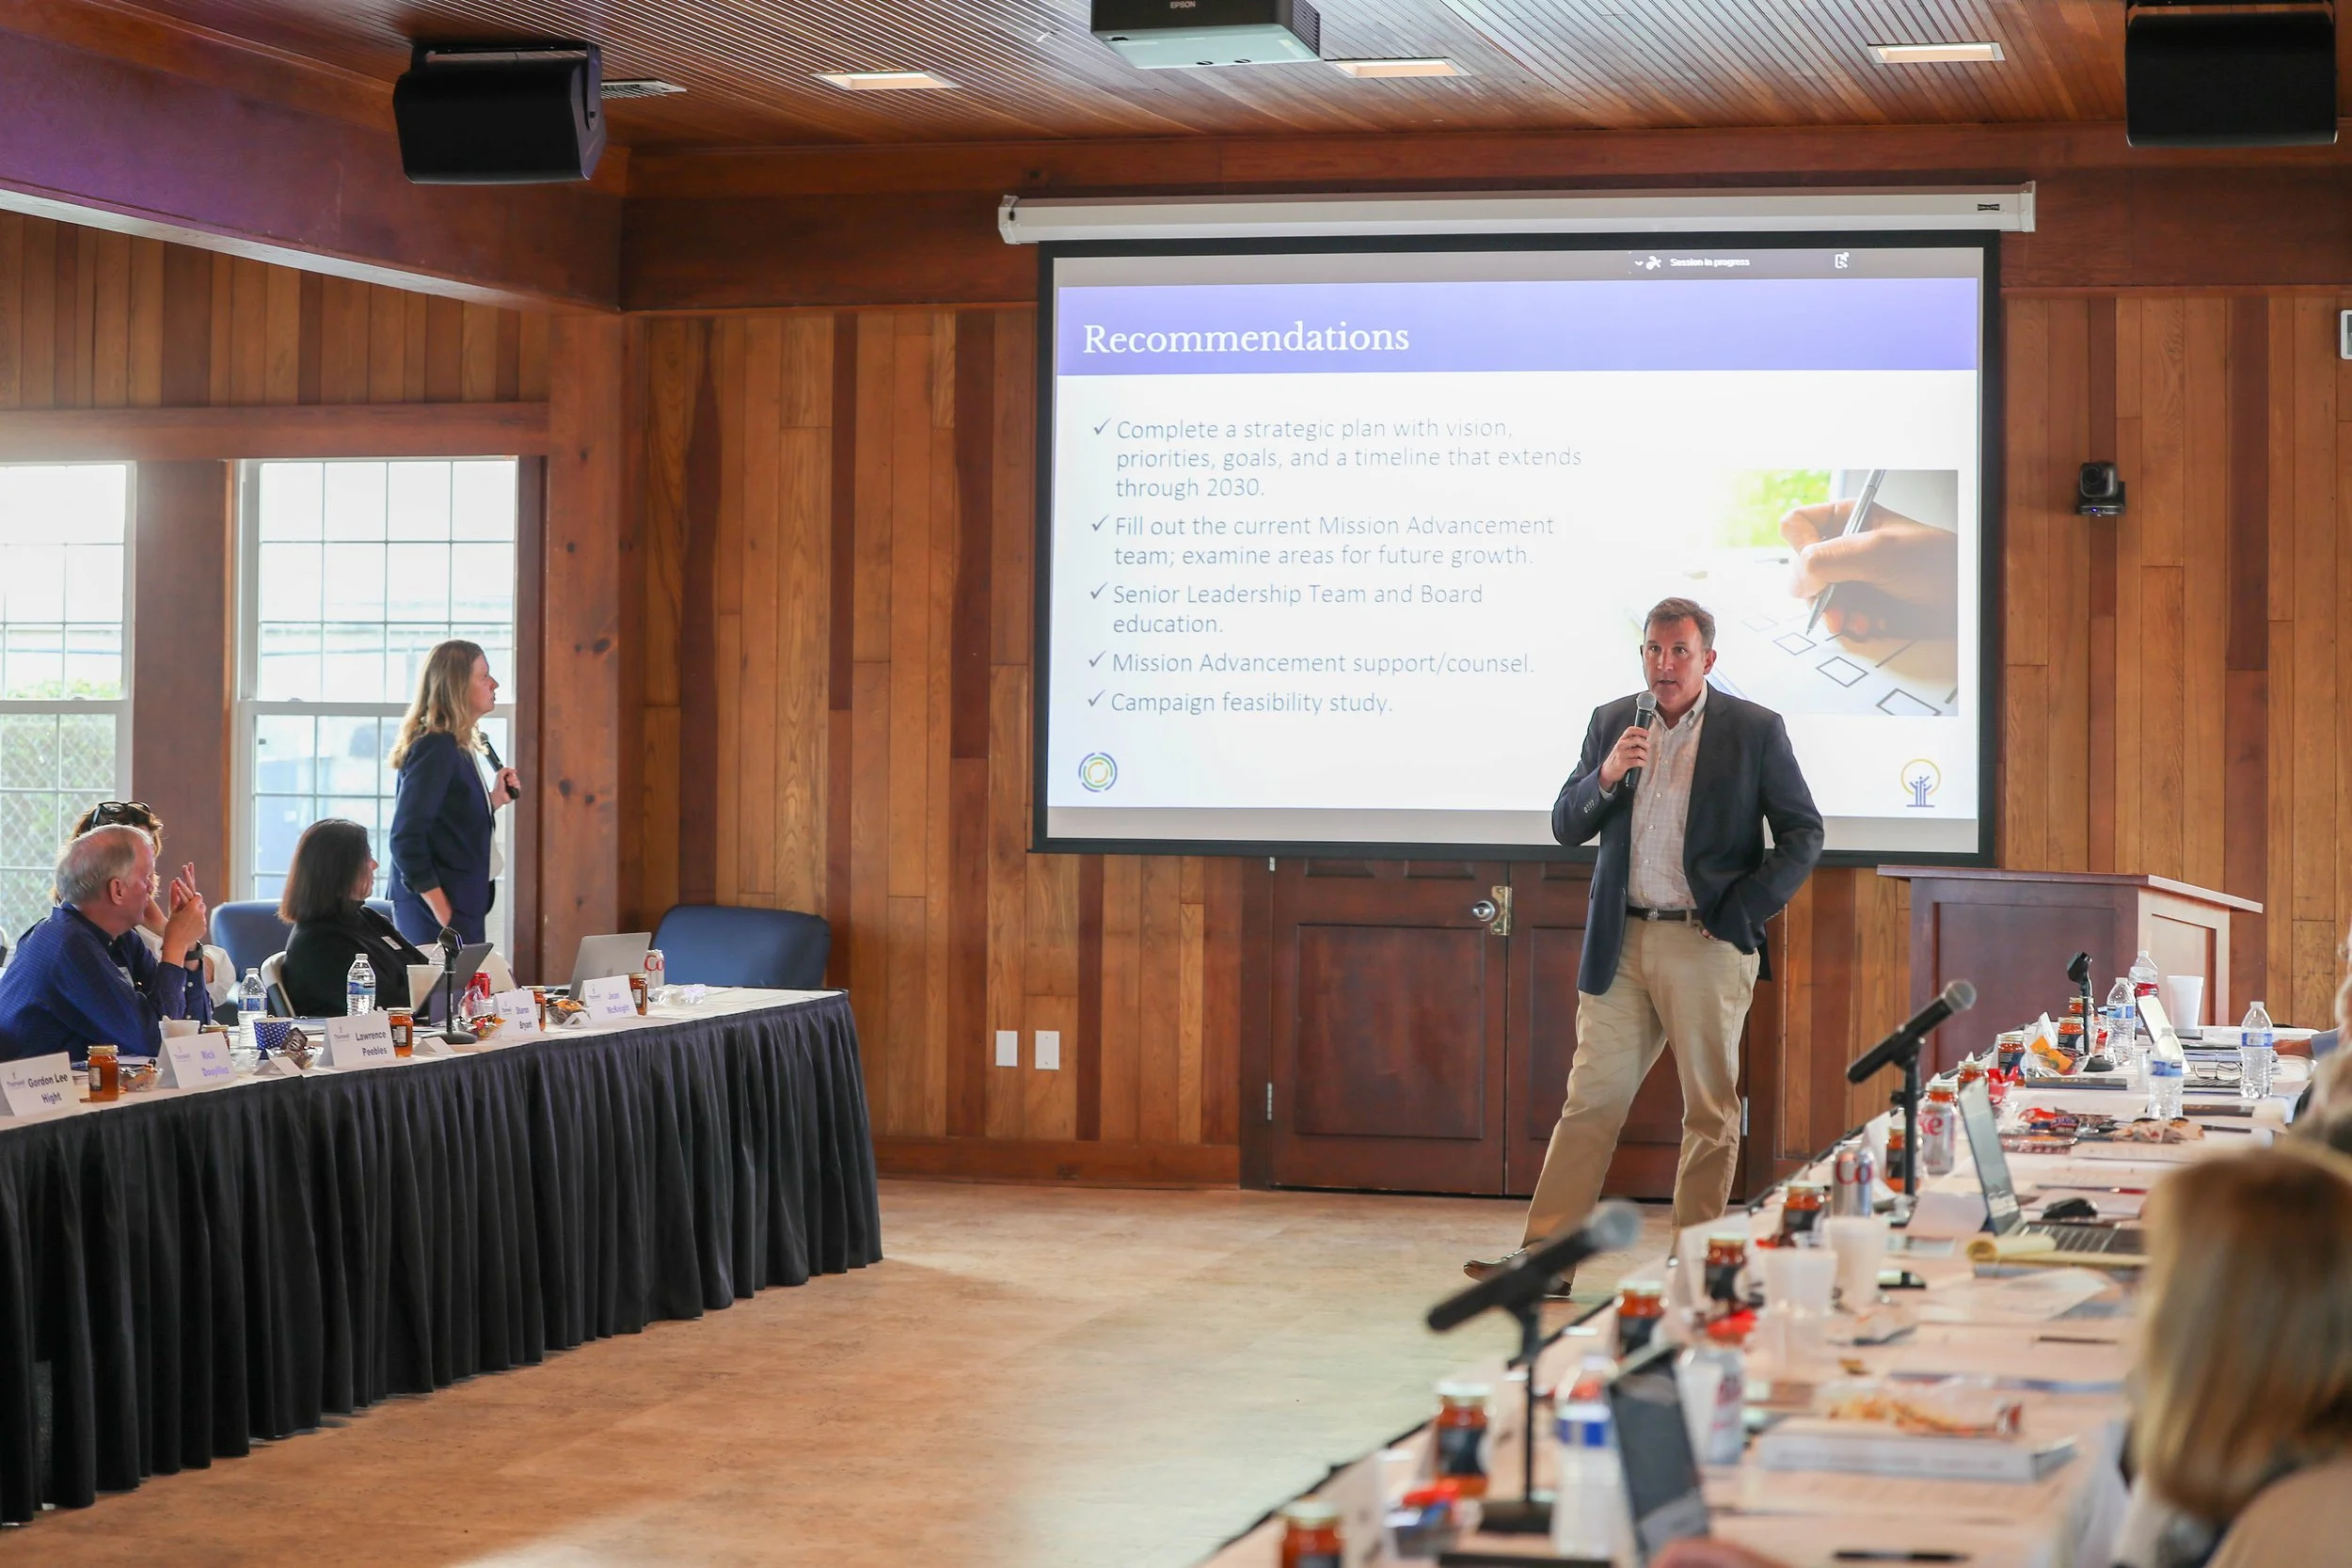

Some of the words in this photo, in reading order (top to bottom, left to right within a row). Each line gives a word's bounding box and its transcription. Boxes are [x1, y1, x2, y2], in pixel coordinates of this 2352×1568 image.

[1169, 1, 1197, 9] EPSON
[1670, 258, 1704, 267] Session
[1713, 259, 1751, 267] progress
[1082, 320, 1409, 354] Recommendations
[1117, 419, 1218, 443] Complete
[1225, 424, 1236, 438] a
[1244, 420, 1335, 442] strategic
[1342, 419, 1386, 441] plan
[1392, 418, 1438, 437] with
[1446, 422, 1513, 440] vision,
[1117, 449, 1216, 472] priorities,
[1222, 447, 1282, 471] goals,
[1290, 447, 1328, 467] and
[1336, 451, 1347, 467] a
[1354, 447, 1441, 467] timeline
[1447, 447, 1491, 467] that
[1498, 446, 1581, 466] extends
[1115, 477, 1199, 501] through
[1206, 478, 1264, 498] 2030.
[1116, 515, 1143, 535] Fill
[1150, 518, 1186, 535] out
[1192, 515, 1227, 535] the
[1233, 516, 1311, 535] current
[1319, 515, 1399, 535] Mission
[1406, 515, 1555, 534] Advancement
[1114, 547, 1174, 568] team;
[1182, 549, 1271, 565] examine
[1278, 549, 1334, 564] areas
[1341, 544, 1372, 564] for
[1378, 544, 1444, 564] future
[1451, 545, 1534, 569] growth.
[1113, 585, 1181, 604] Senior
[1187, 583, 1302, 608] Leadership
[1308, 584, 1366, 603] Team
[1374, 583, 1413, 603] and
[1422, 583, 1483, 604] Board
[1113, 613, 1223, 633] education.
[1113, 653, 1192, 673] Mission
[1199, 652, 1346, 673] Advancement
[1353, 652, 1534, 677] support/counsel.
[1111, 692, 1215, 716] Campaign
[1221, 691, 1324, 716] feasibility
[1329, 691, 1393, 716] study.
[355, 1031, 388, 1042] Lawrence
[361, 1045, 389, 1057] Peebles
[27, 1075, 55, 1088] Gordon
[54, 1072, 69, 1084] Lee
[41, 1092, 62, 1104] Hight
